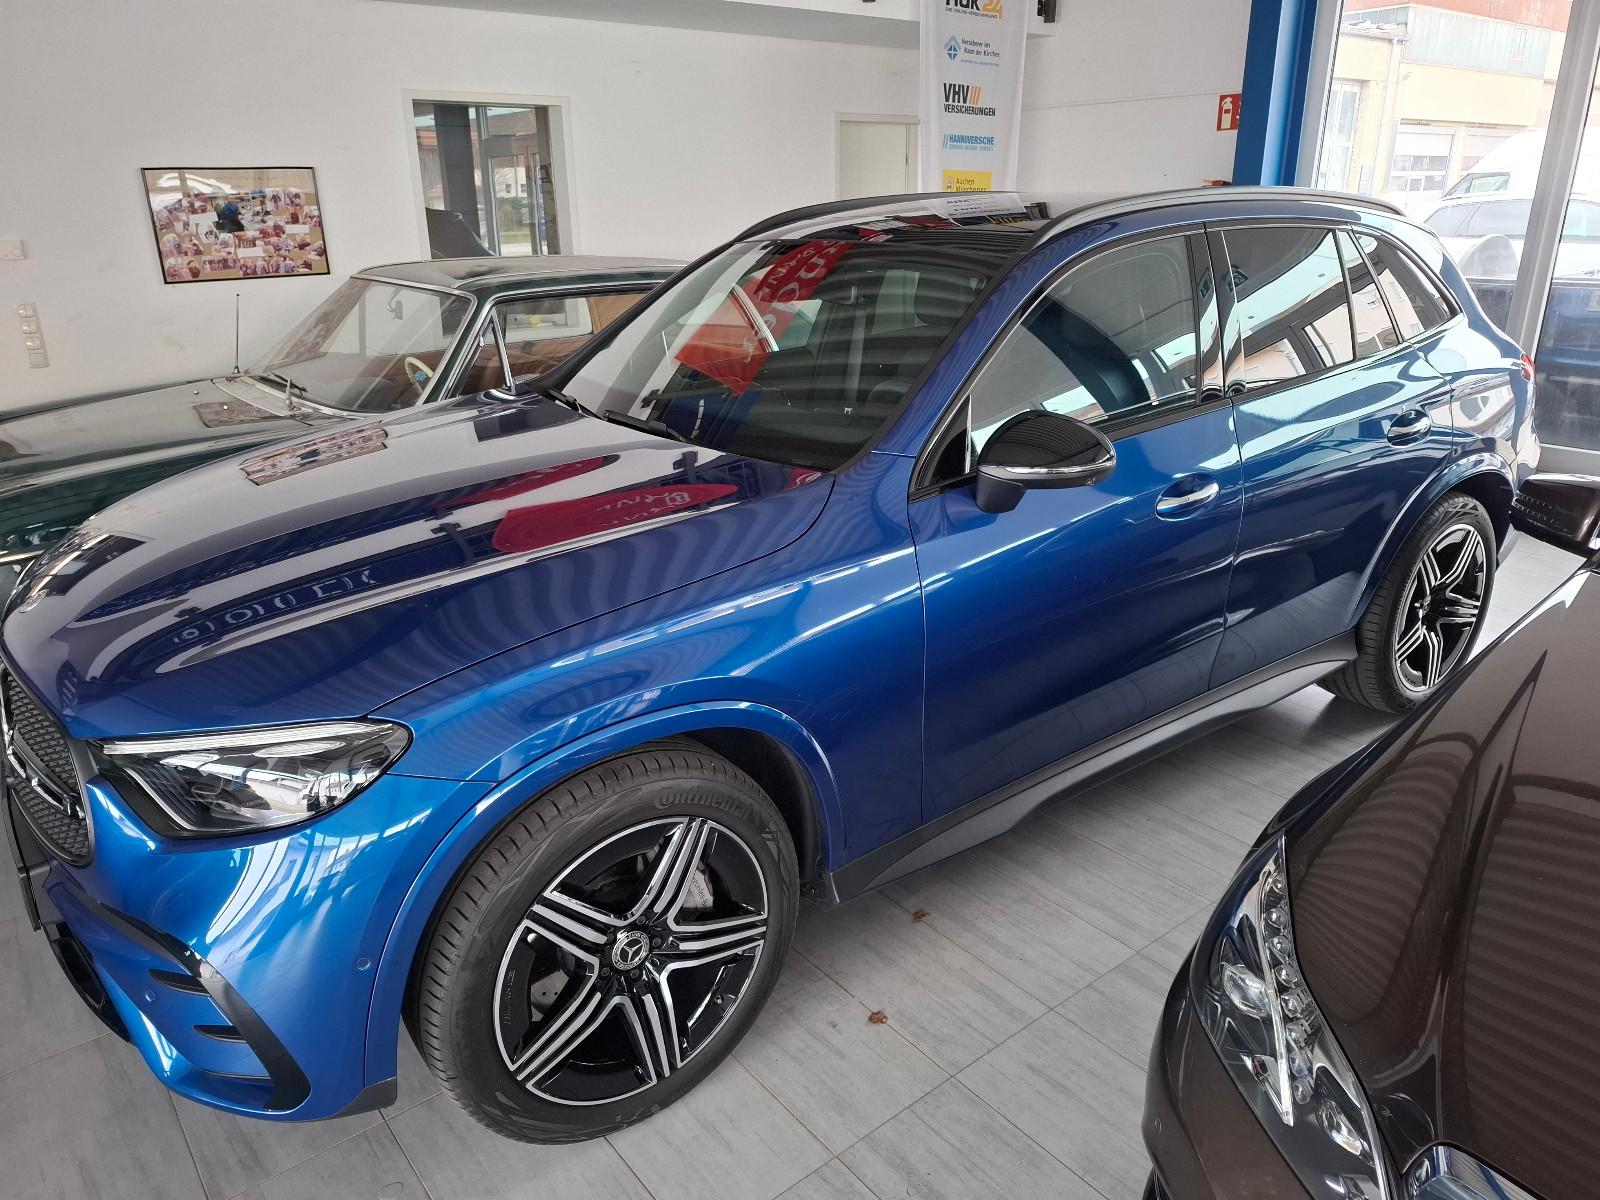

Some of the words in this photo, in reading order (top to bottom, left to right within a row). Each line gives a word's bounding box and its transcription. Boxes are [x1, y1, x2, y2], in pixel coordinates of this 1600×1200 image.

[944, 103, 996, 117] VERSICHERUNGEN
[949, 133, 995, 146] HANNOVERSCHE
[655, 785, 754, 822] Continental
